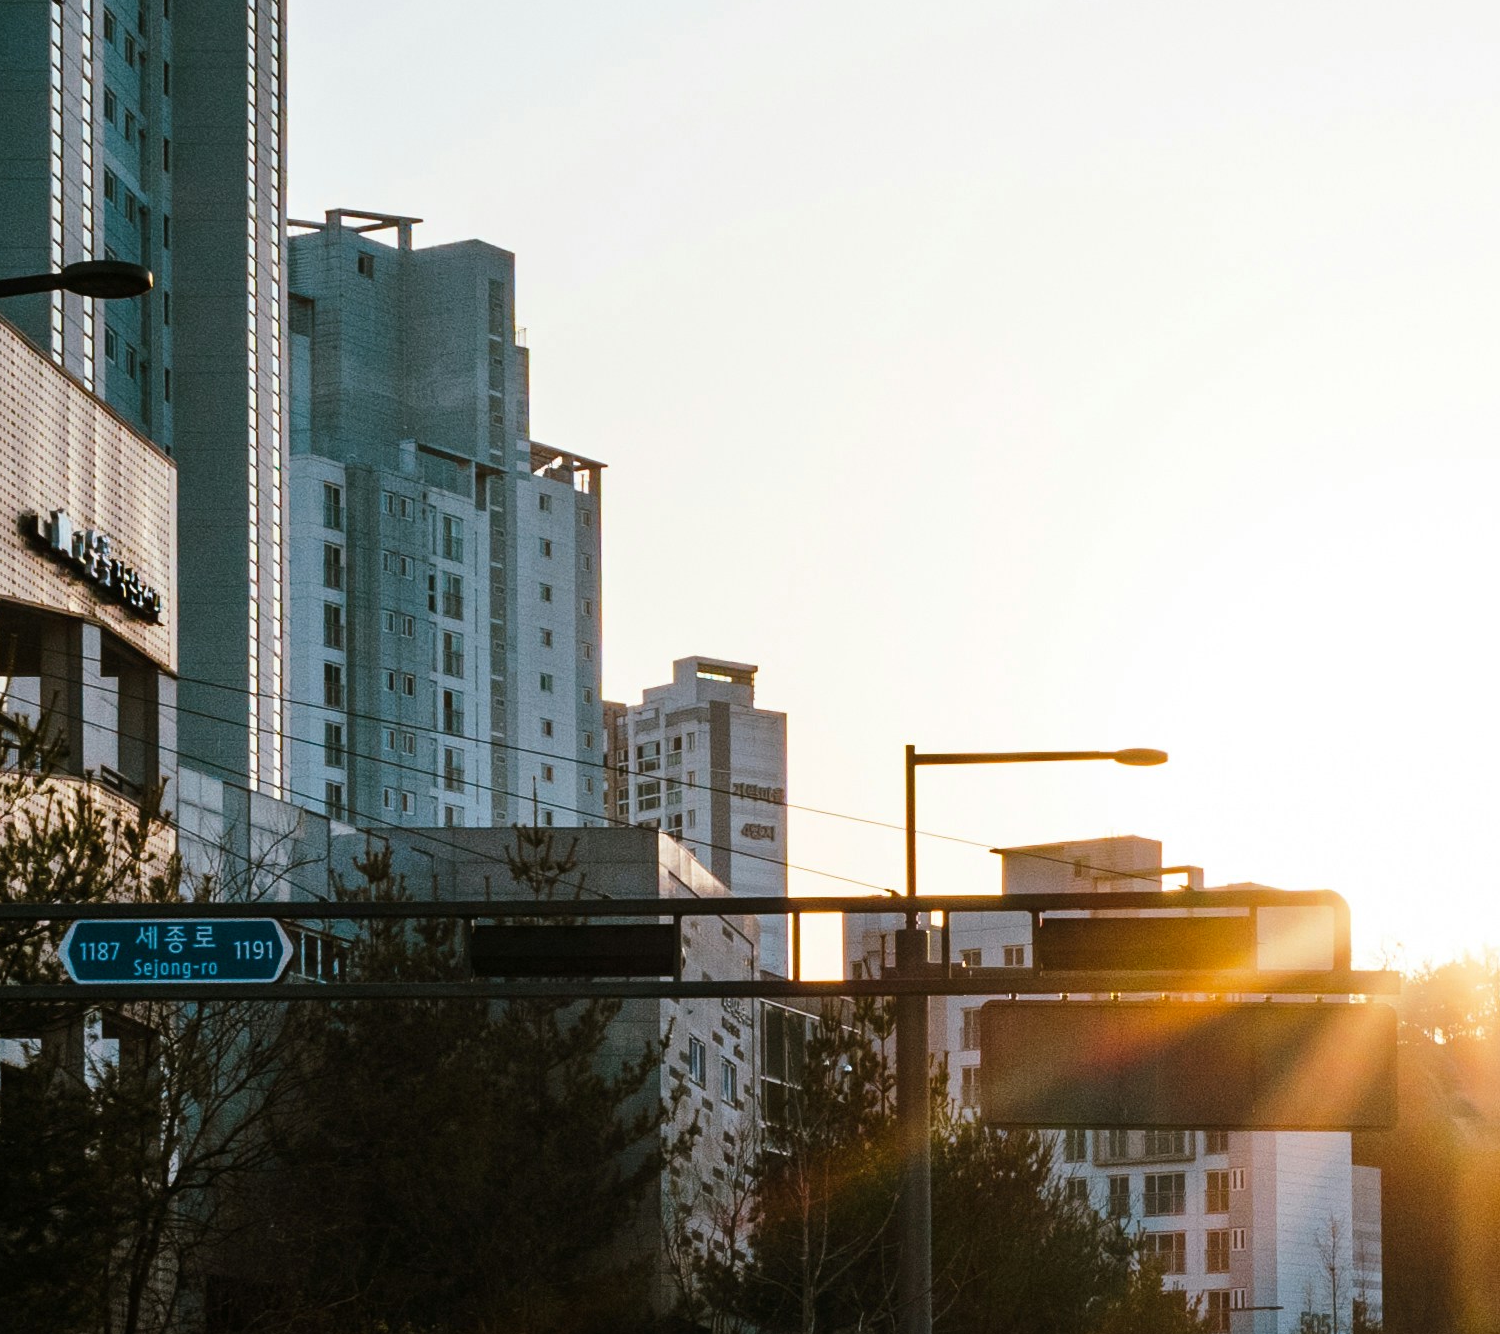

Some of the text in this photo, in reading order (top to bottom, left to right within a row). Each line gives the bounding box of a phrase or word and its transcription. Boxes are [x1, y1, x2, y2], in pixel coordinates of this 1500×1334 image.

[134, 924, 217, 955] 세종로
[79, 941, 120, 961] 1187
[234, 940, 274, 960] 1191
[133, 959, 218, 979] Sejong-ro
